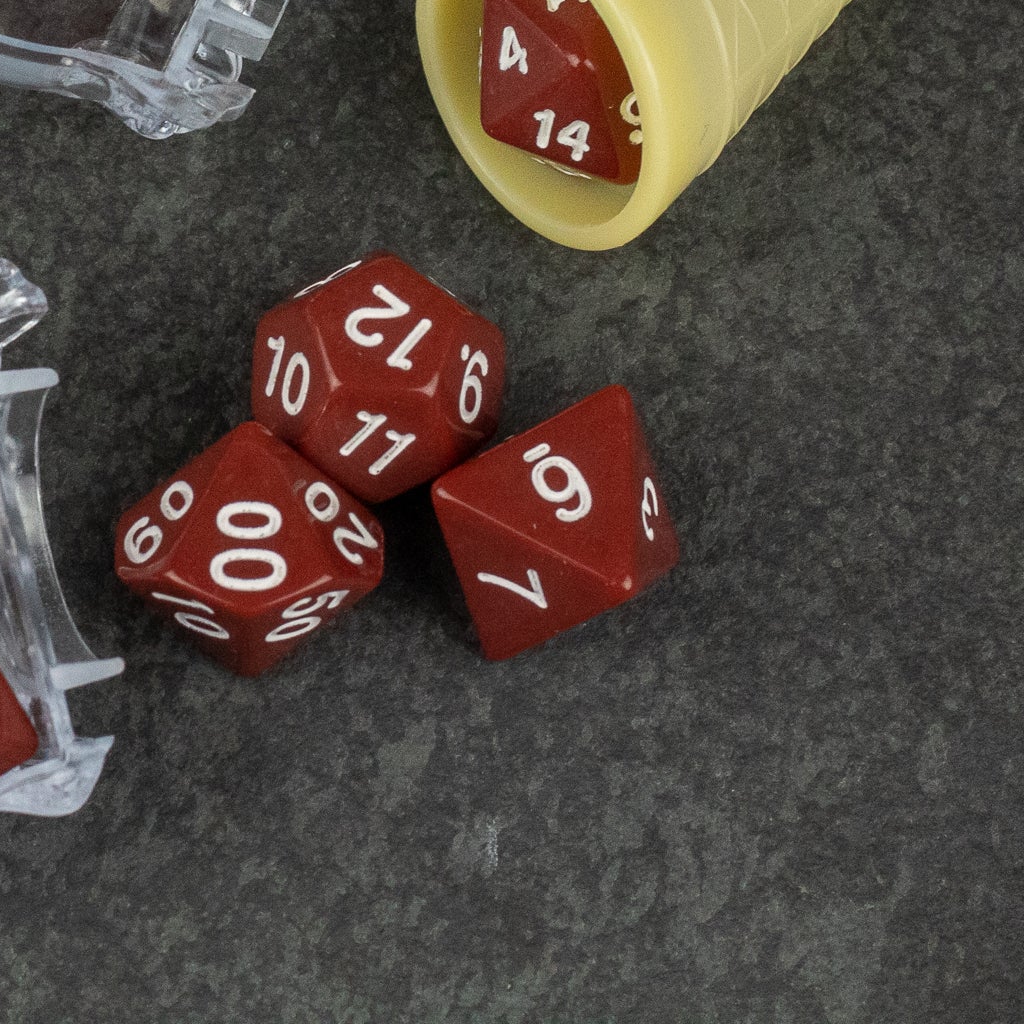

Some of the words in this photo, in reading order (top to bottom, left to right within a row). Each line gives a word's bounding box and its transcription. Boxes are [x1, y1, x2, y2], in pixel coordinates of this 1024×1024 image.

[499, 26, 528, 75] 4
[533, 109, 591, 162] 14
[344, 284, 433, 371] 12
[267, 335, 311, 417] 10
[339, 410, 417, 476] 11
